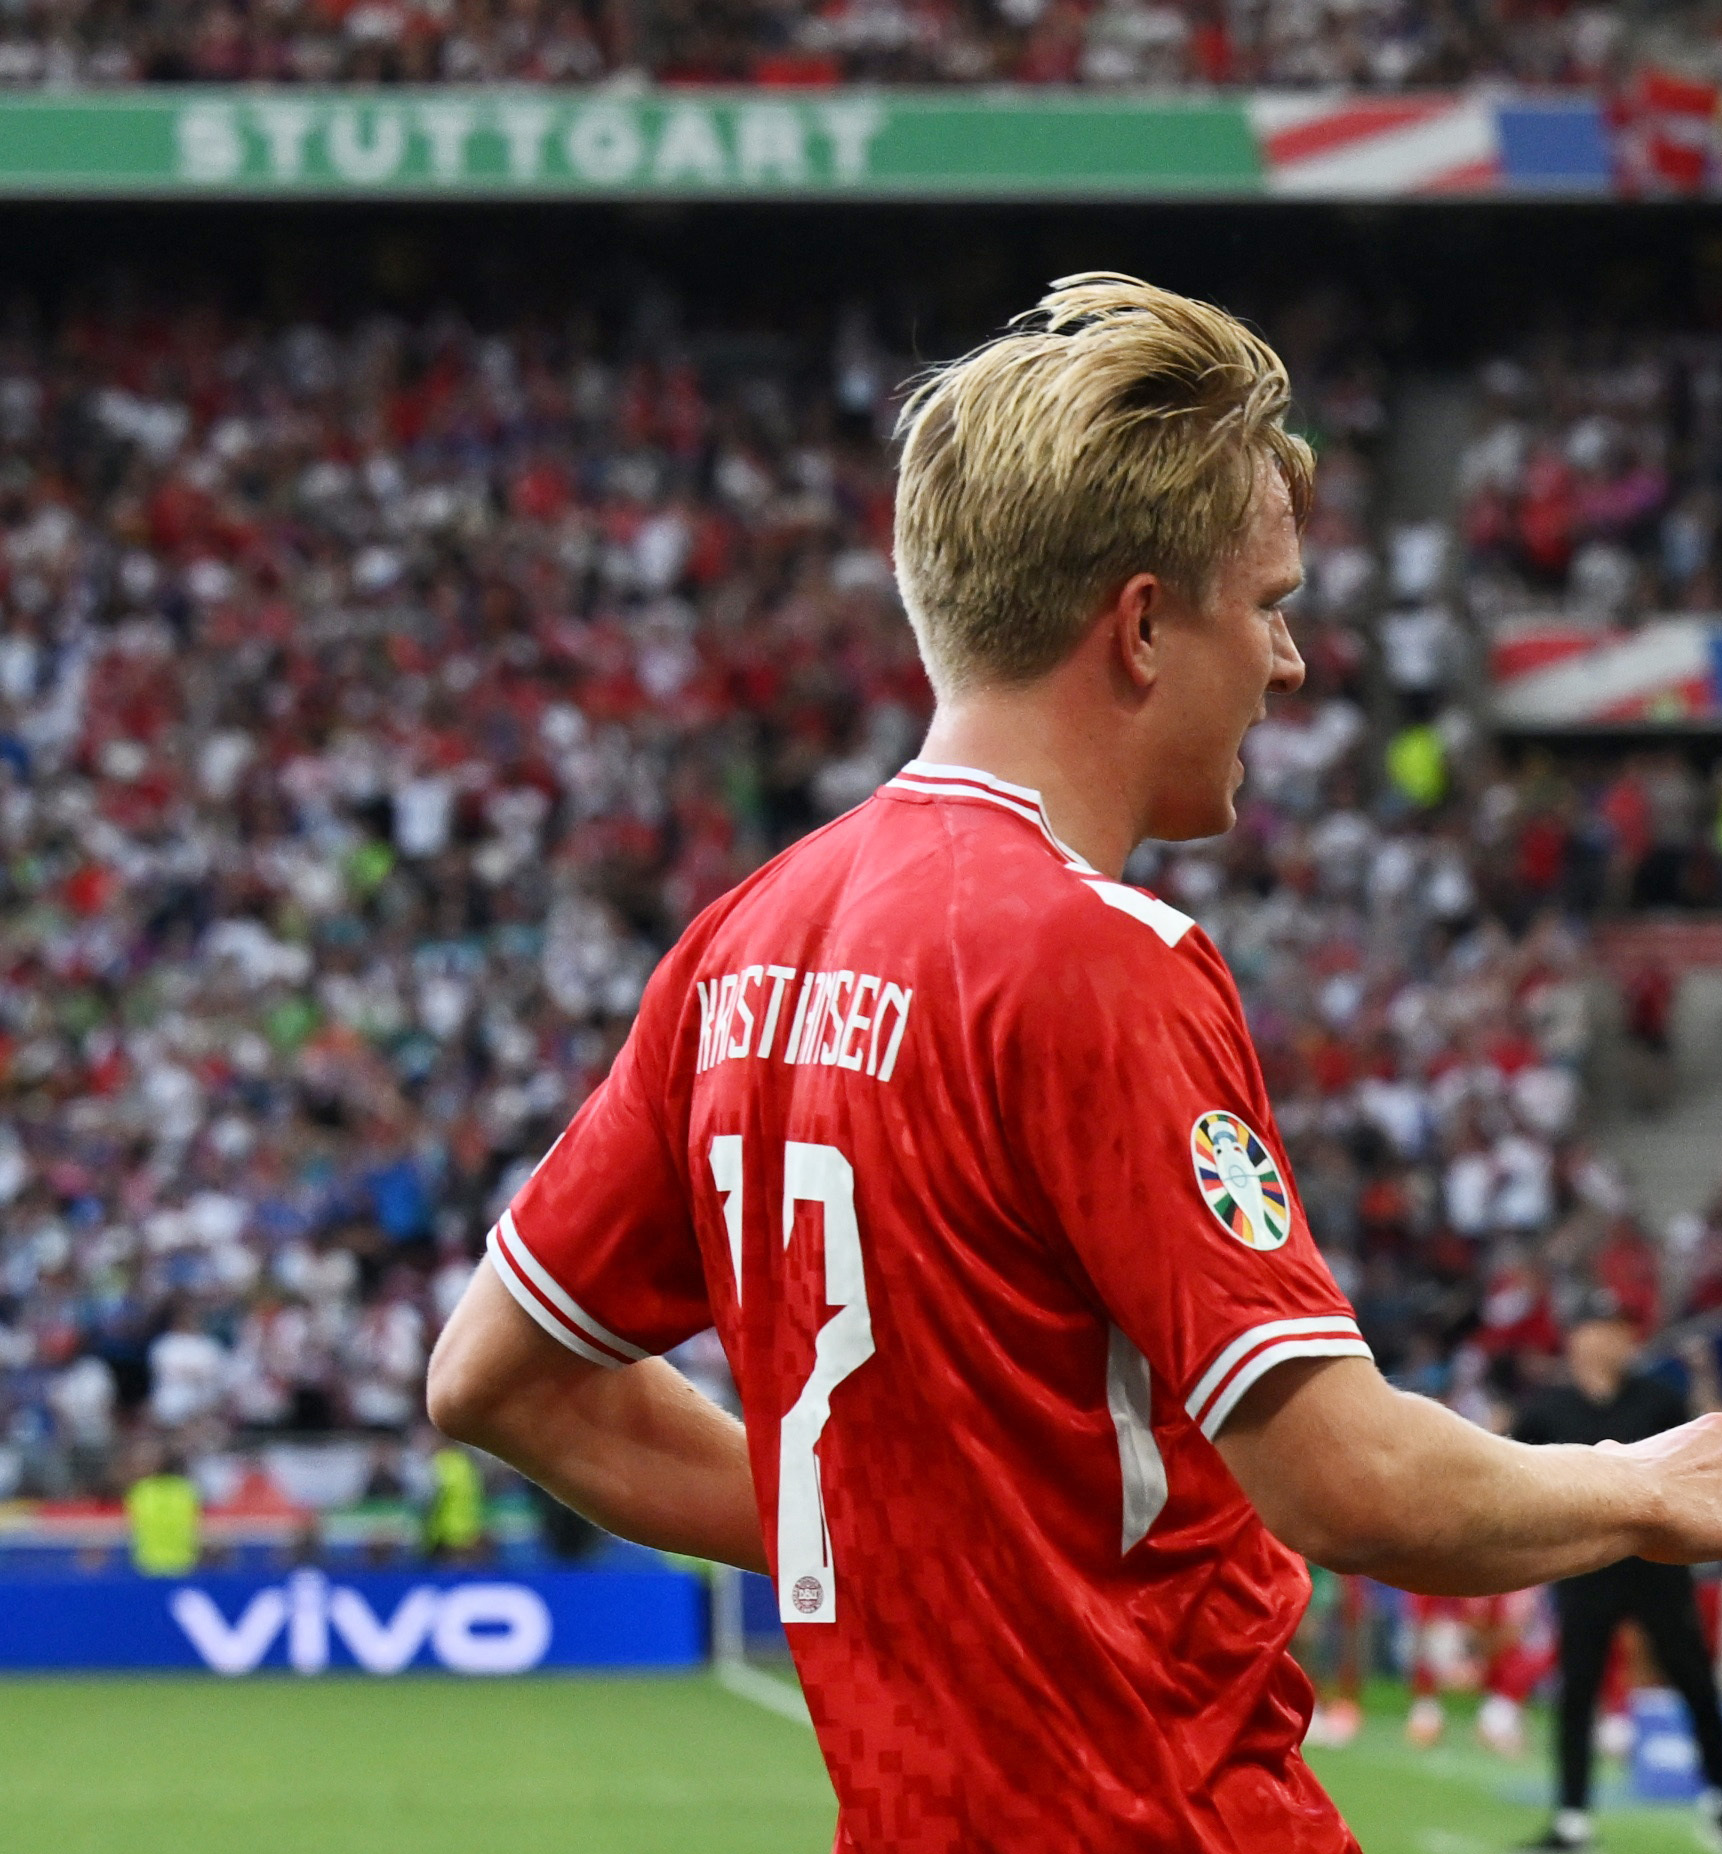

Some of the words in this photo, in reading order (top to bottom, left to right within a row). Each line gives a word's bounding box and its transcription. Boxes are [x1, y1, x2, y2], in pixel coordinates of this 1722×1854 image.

[178, 100, 882, 184] STUTTGART
[708, 1135, 876, 1623] 17
[170, 1567, 553, 1676] vivo
